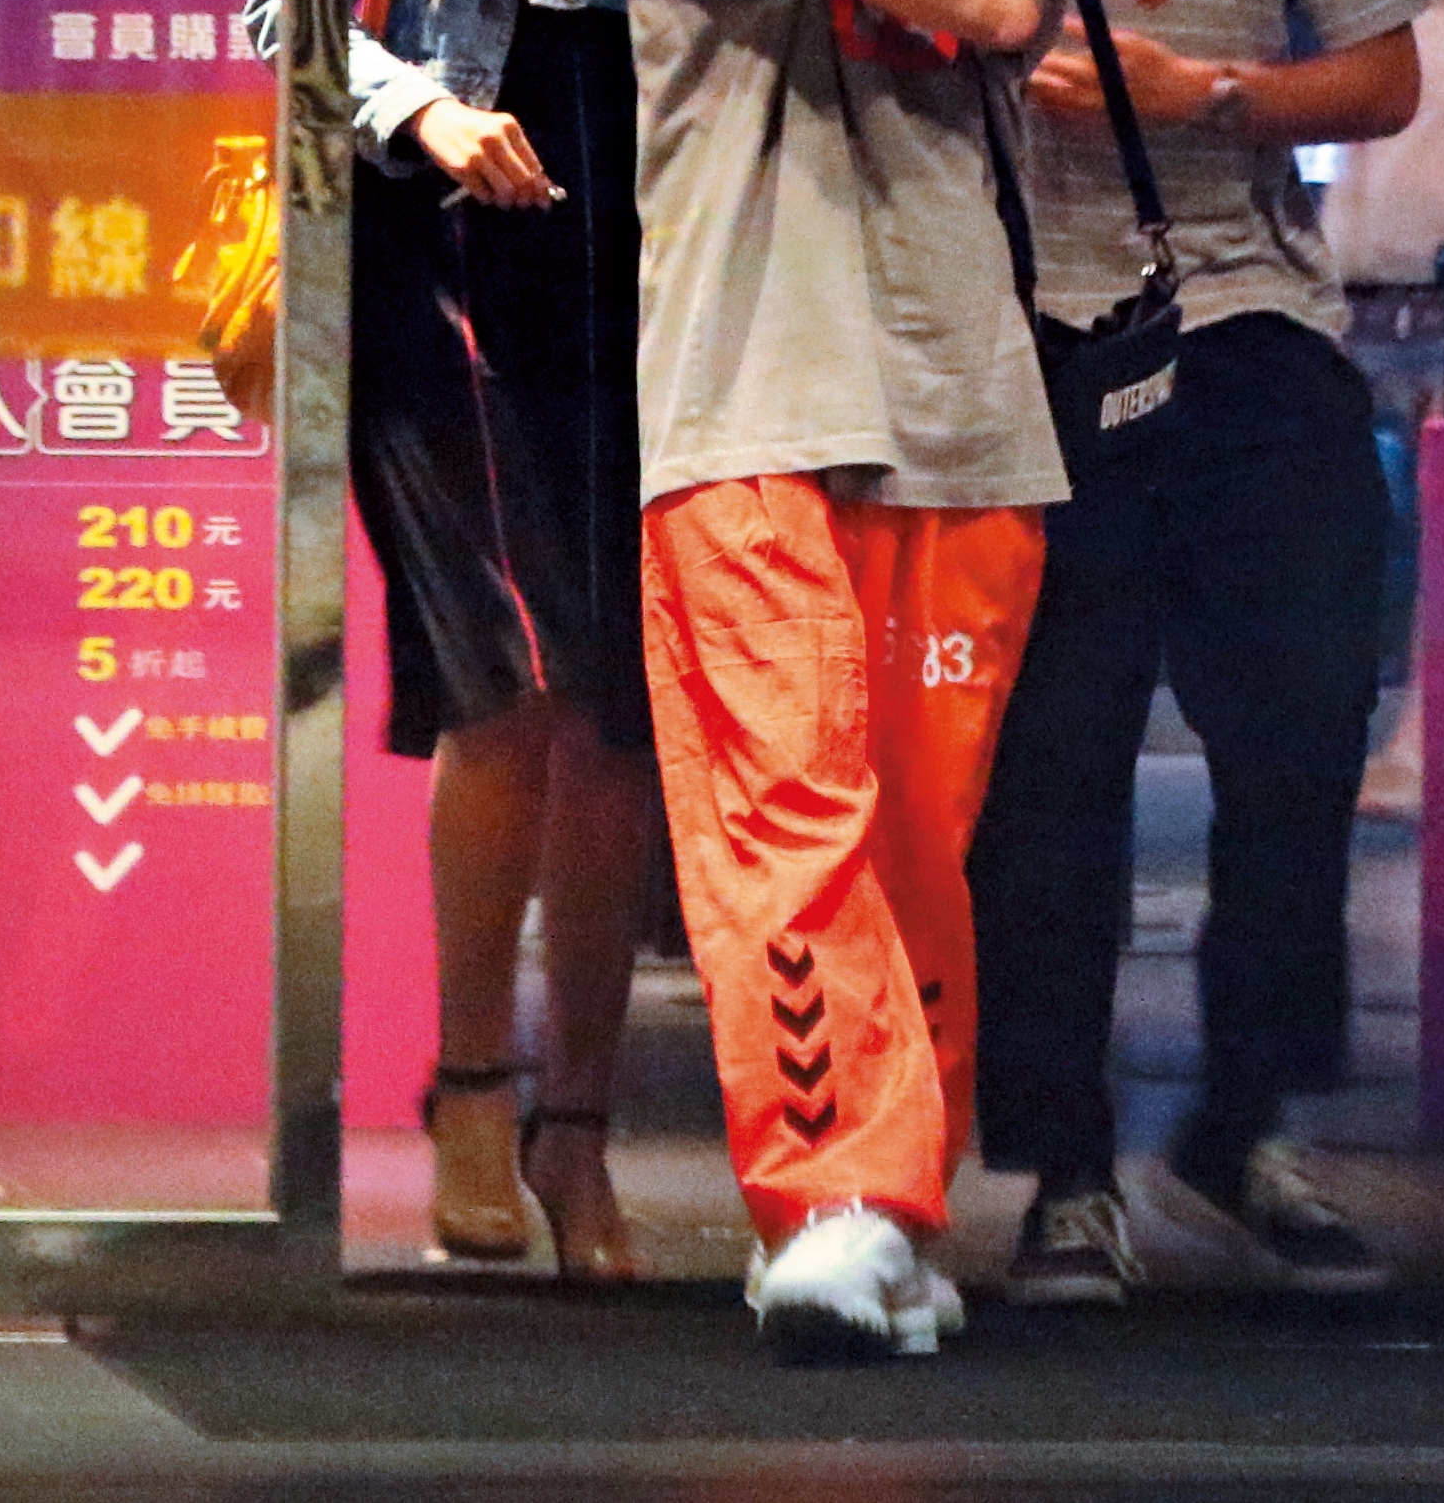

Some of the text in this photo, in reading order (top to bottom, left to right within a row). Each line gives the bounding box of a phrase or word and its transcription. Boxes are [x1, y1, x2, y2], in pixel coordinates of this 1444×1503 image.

[77, 505, 243, 549] 210 元
[77, 566, 243, 610] 220 元
[77, 636, 117, 682] 5
